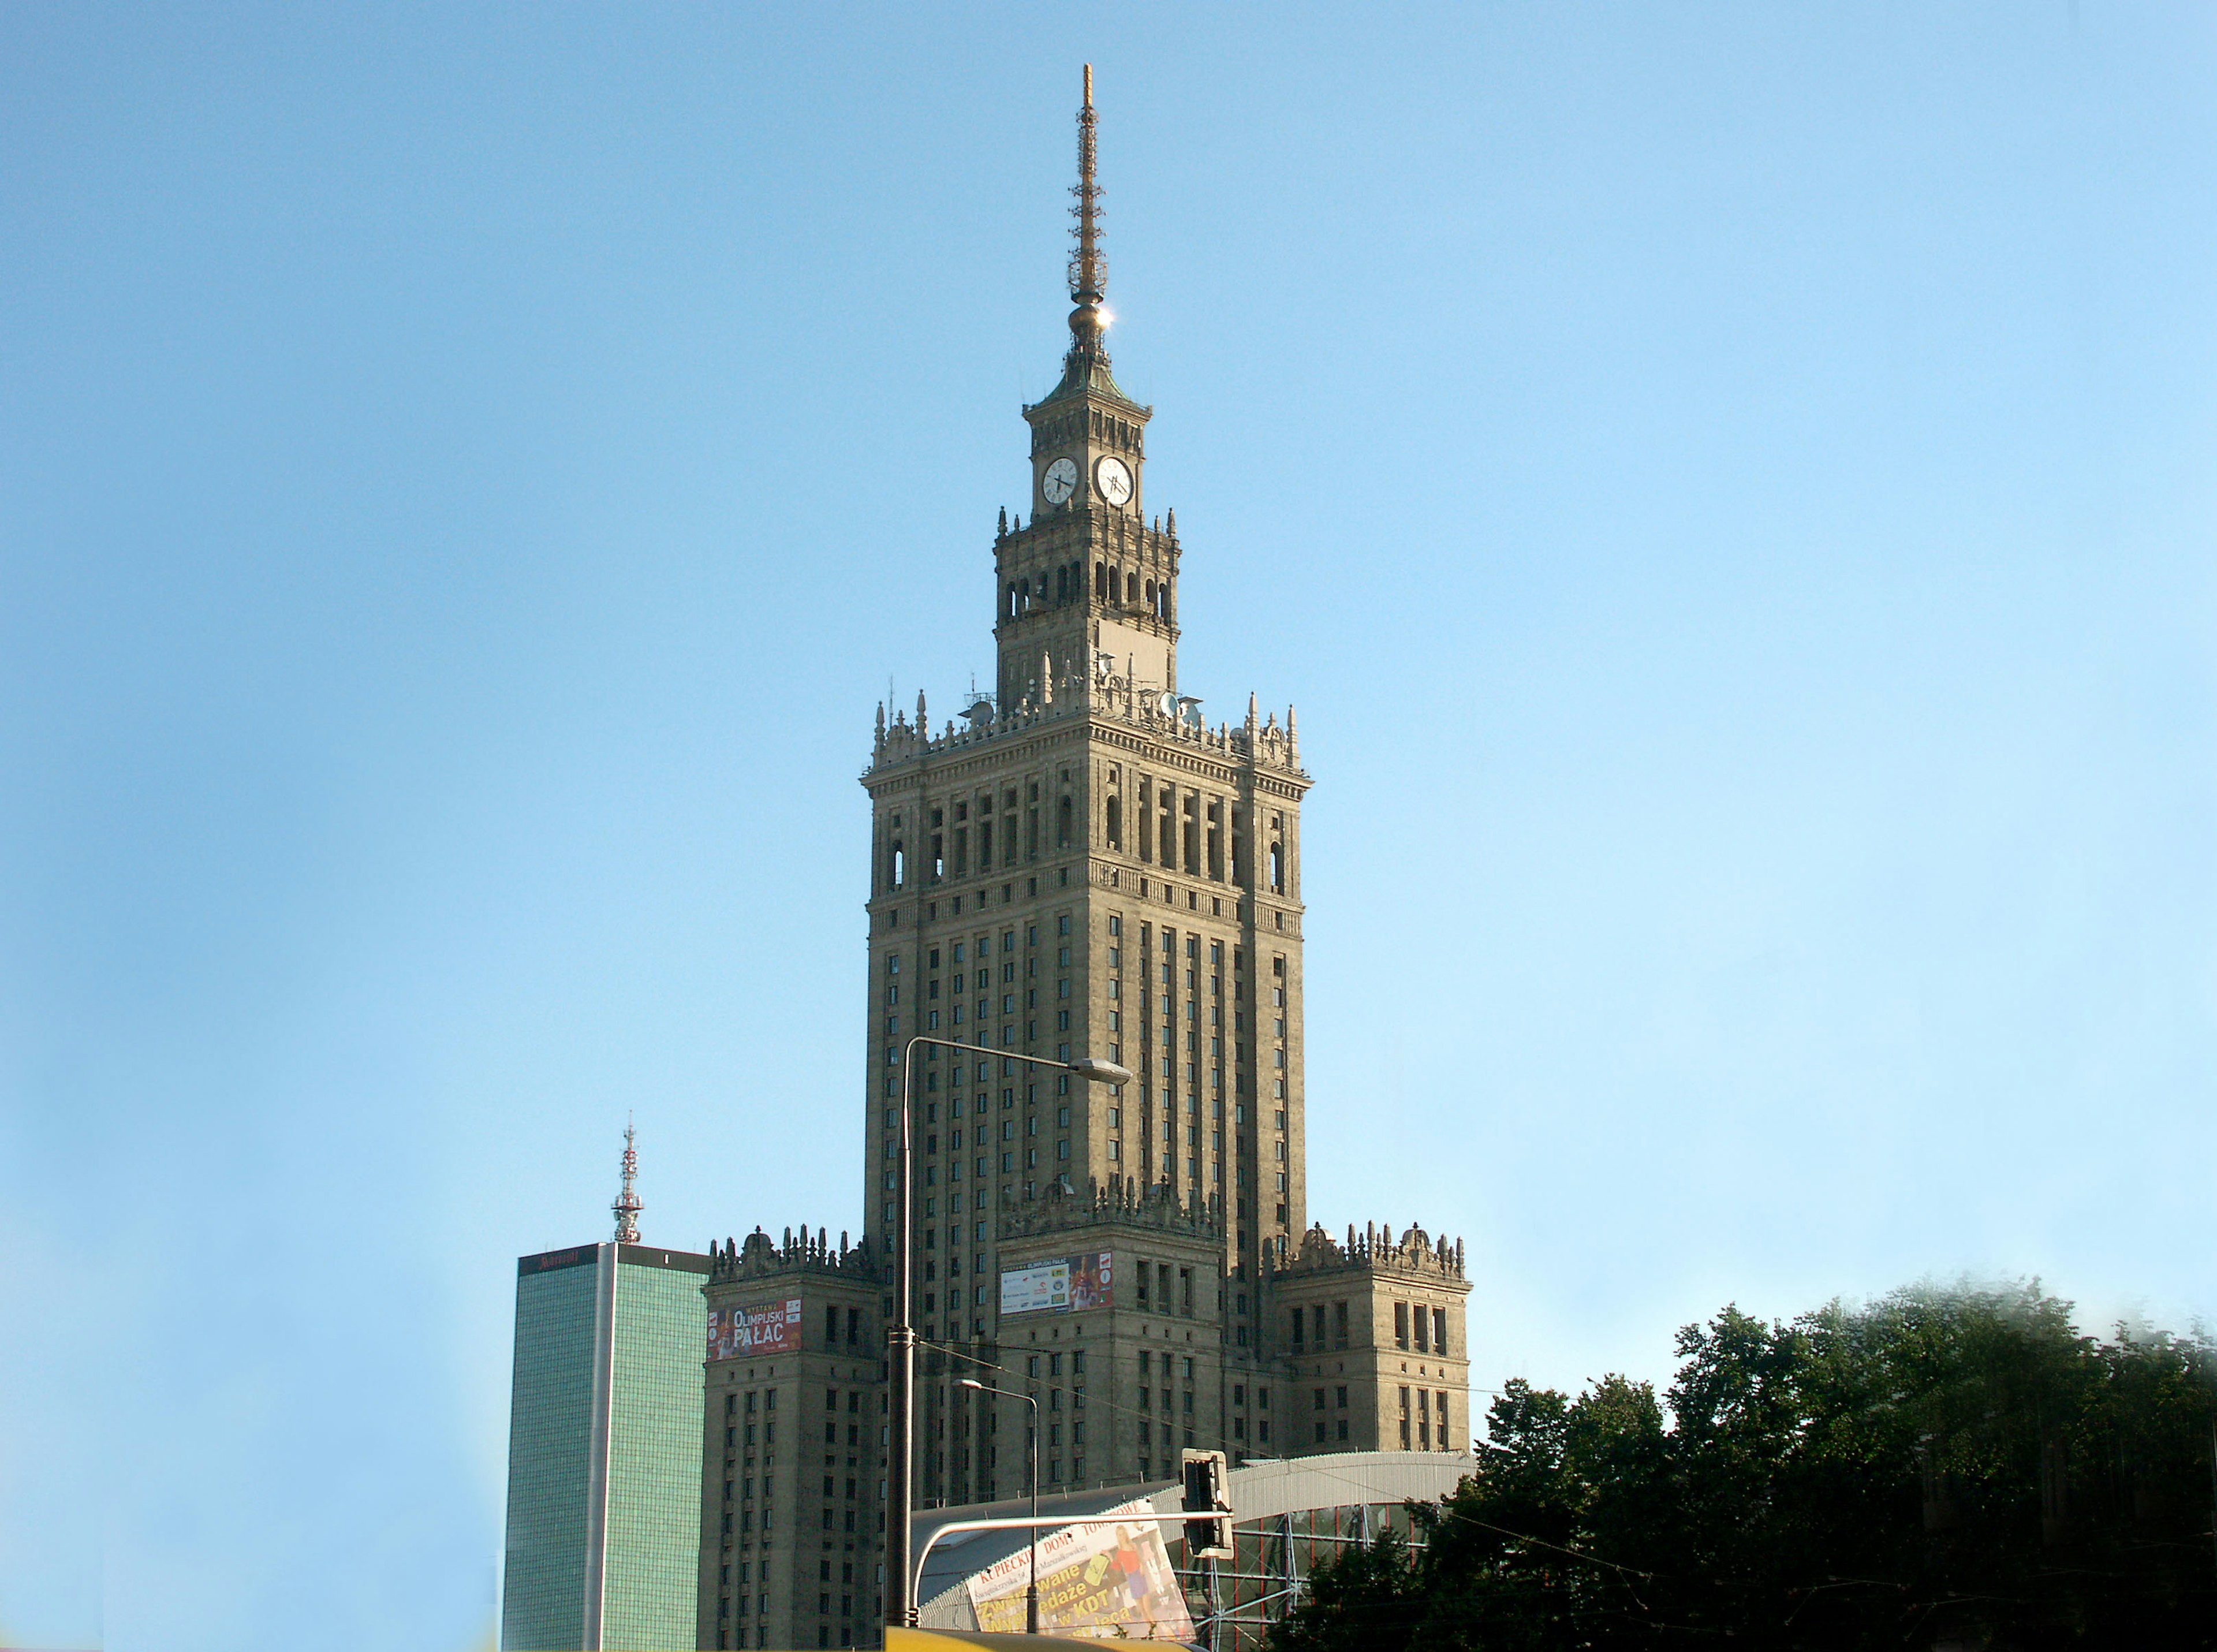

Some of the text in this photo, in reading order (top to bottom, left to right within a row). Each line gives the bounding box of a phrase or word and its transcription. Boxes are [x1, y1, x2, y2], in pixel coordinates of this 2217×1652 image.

[734, 1323, 783, 1347] PAŁAC
[979, 1564, 1080, 1619] Zwariwane
[985, 1581, 1087, 1633] Wypredaże
[1058, 1589, 1110, 1626] w KDT
[1095, 1607, 1132, 1632] lecą
